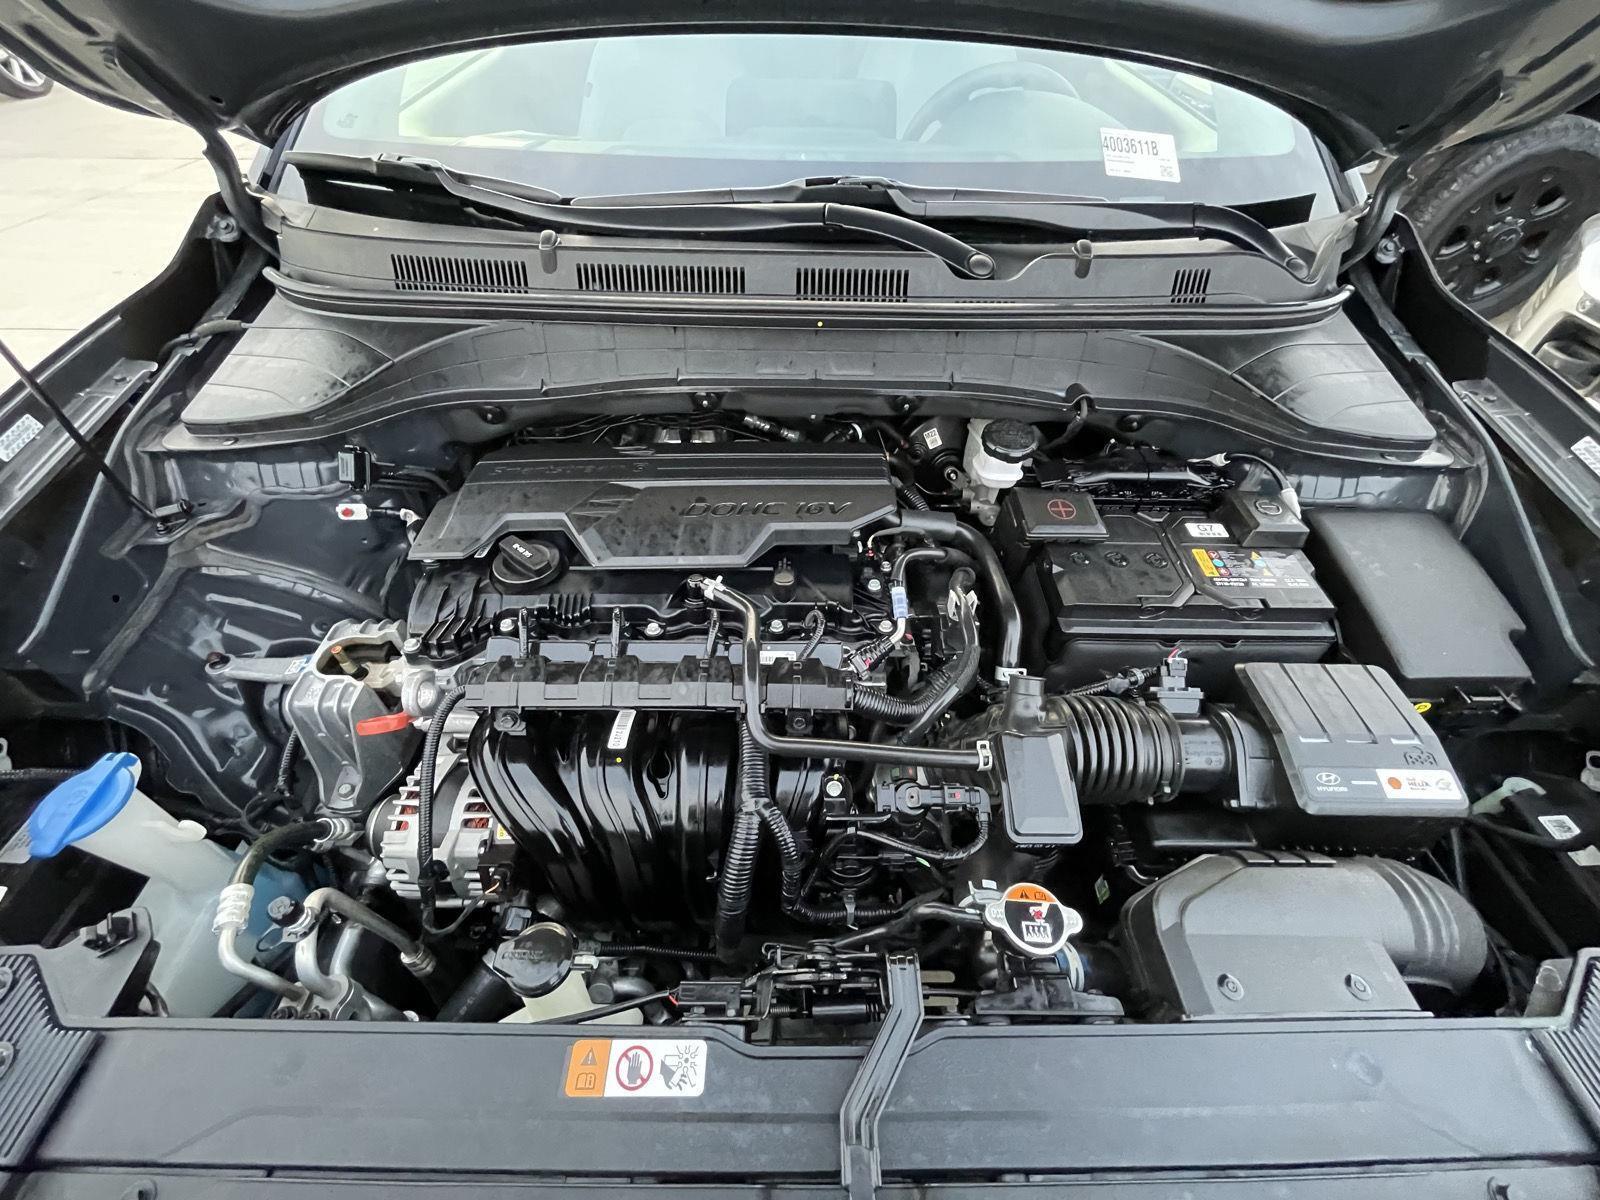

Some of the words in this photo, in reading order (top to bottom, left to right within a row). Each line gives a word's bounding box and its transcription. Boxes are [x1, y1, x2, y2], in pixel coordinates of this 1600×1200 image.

[1103, 136, 1159, 156] 4003611B
[683, 501, 787, 517] DOHC
[796, 501, 852, 516] 16V
